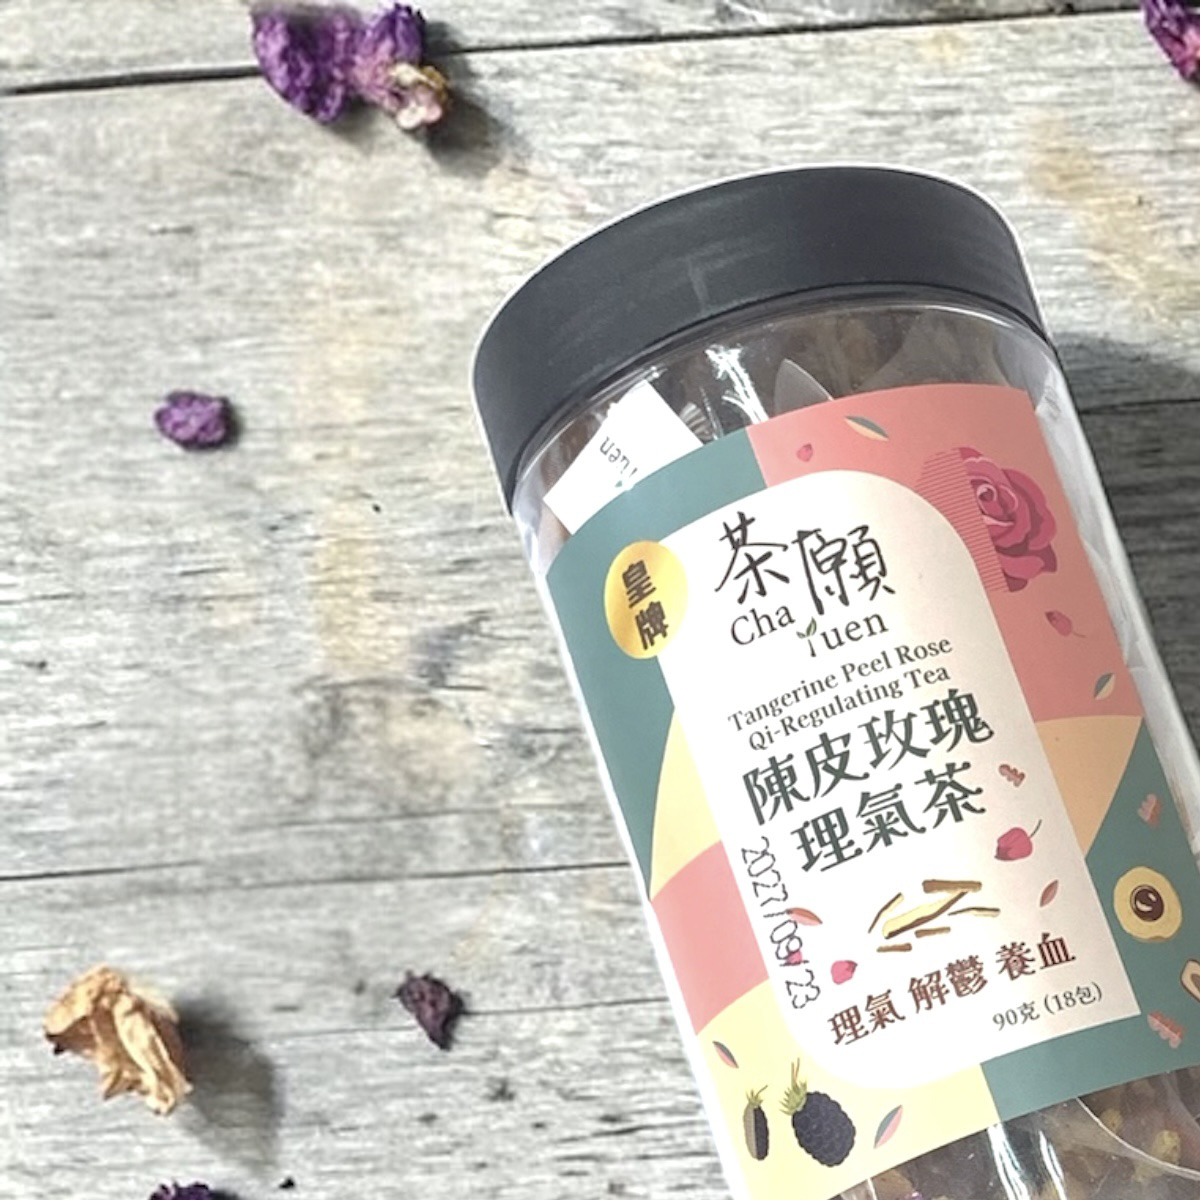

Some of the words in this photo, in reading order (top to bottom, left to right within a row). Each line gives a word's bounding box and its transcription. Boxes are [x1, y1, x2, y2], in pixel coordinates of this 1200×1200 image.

[622, 559, 669, 650] 皇牌
[730, 604, 795, 645] Cha
[728, 673, 839, 731] Tangerine
[841, 651, 892, 684] Peel
[894, 638, 953, 665] Rose
[749, 678, 904, 751] Qi-Regulating
[903, 665, 951, 690] Tea
[742, 689, 994, 826] 陳皮玫瑰
[790, 761, 986, 872] 理氣茶
[827, 989, 906, 1045] 理氣
[908, 955, 988, 1013] 解鬱
[995, 932, 1076, 981] 養血
[992, 1002, 1040, 1031] 90克
[1043, 982, 1103, 1014] (18包)
